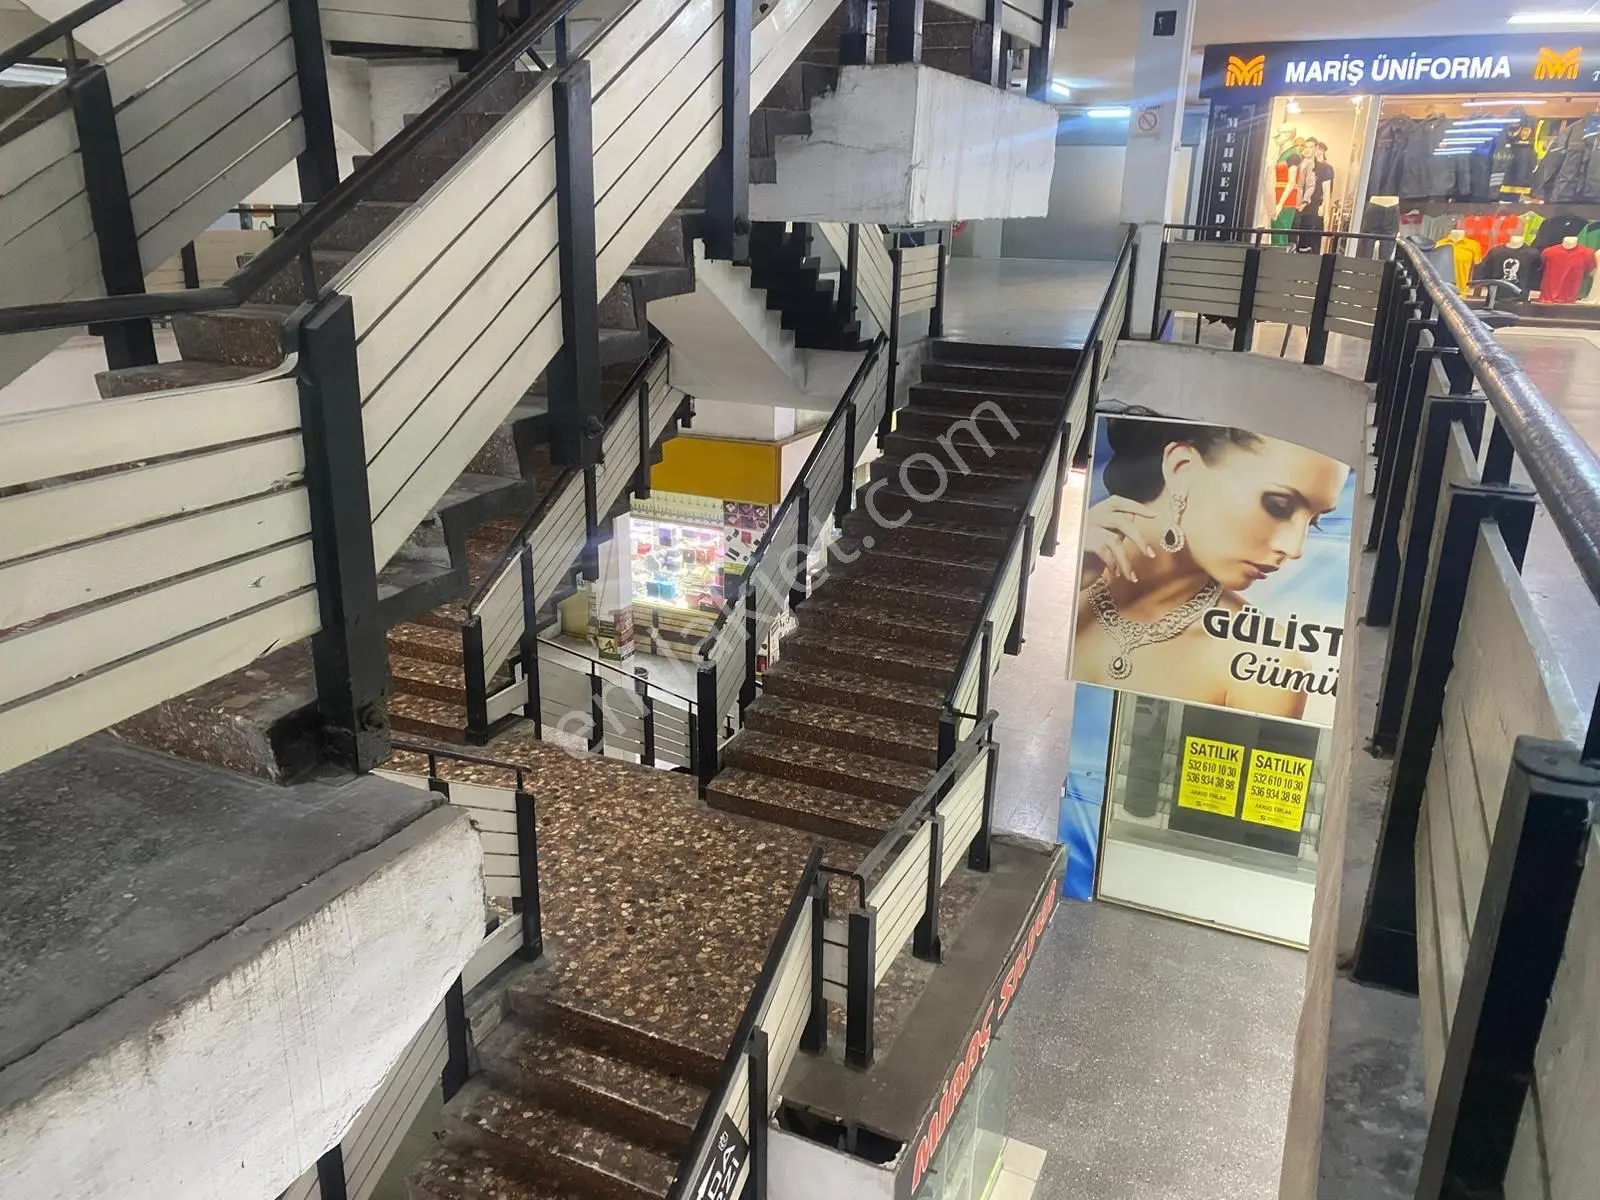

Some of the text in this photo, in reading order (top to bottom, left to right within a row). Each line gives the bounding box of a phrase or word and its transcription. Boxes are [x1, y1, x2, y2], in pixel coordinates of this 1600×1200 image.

[1285, 51, 1511, 86] MARİŞ ÜNİFORMA
[1219, 118, 1239, 202] MEHMET
[1203, 606, 1344, 657] GÜLİST
[1190, 741, 1239, 762] SATILIK
[1188, 759, 1237, 777] 532 610 10 30
[1255, 754, 1306, 777] SATILIK
[1201, 774, 1214, 786] 934
[1253, 772, 1303, 791] 532 610 10 30
[1251, 785, 1301, 804] 536 934 38 98
